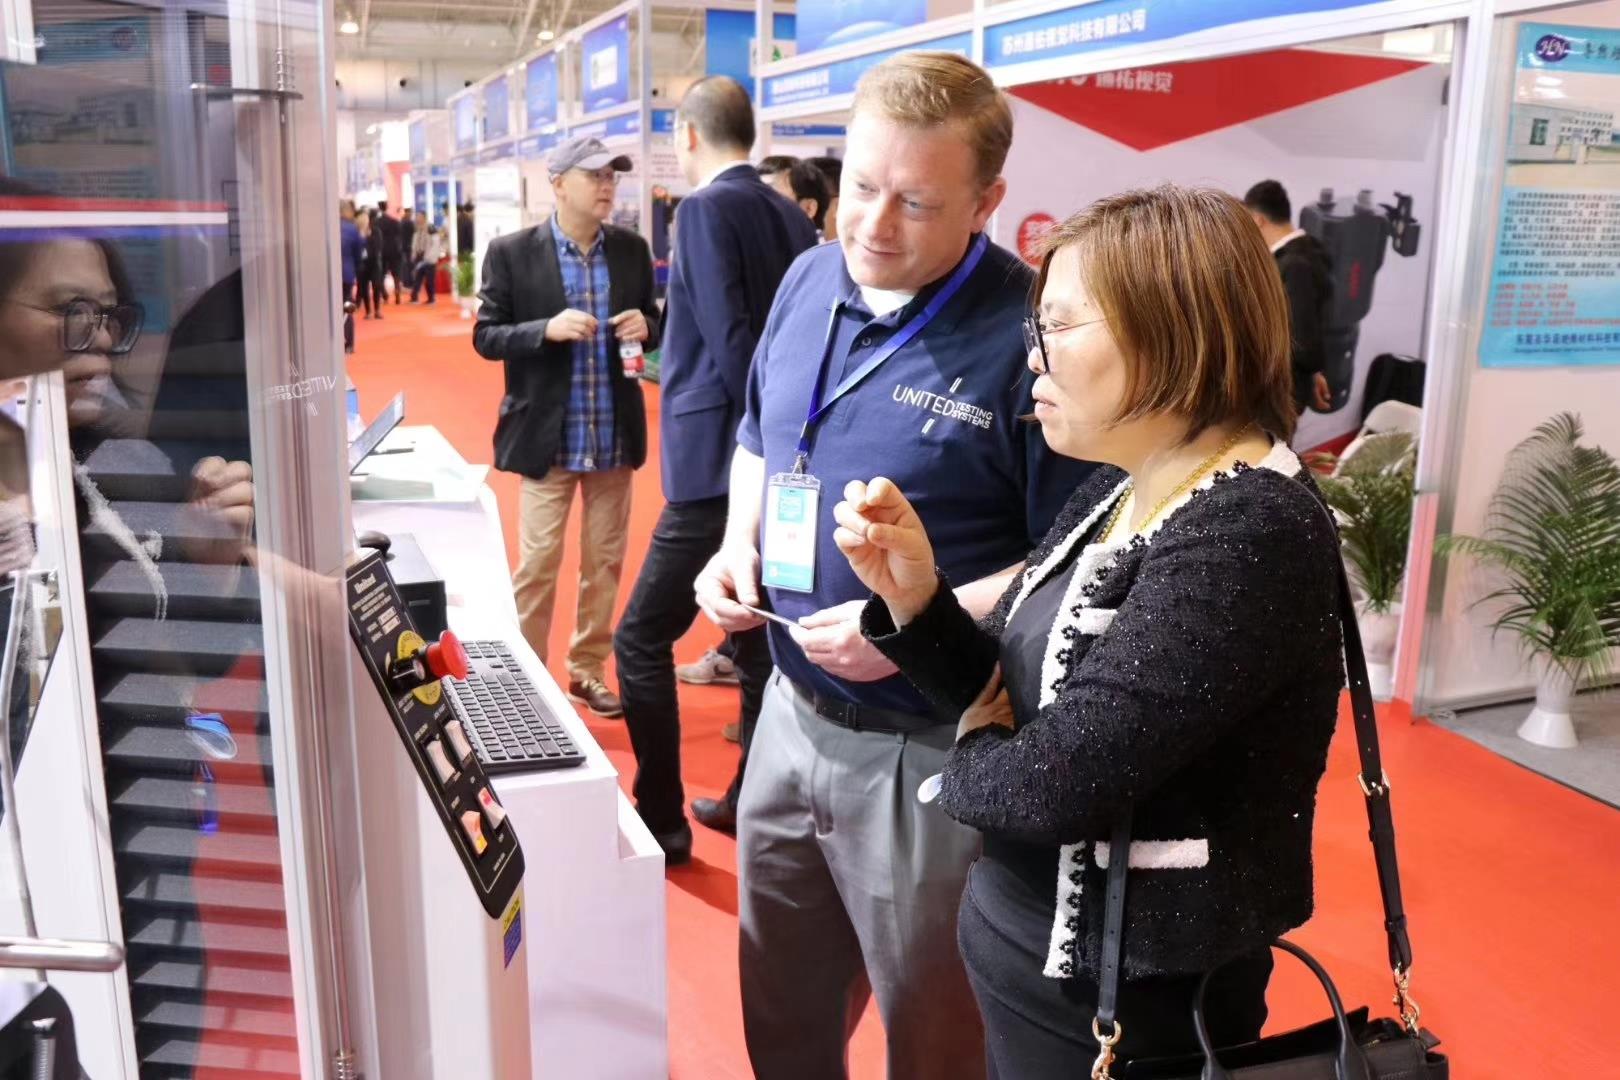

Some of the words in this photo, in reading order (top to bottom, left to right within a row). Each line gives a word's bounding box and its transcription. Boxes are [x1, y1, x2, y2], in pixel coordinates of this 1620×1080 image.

[892, 383, 956, 417] UNITED
[951, 409, 991, 429] SYSTEMS
[955, 401, 993, 421] TESTING
